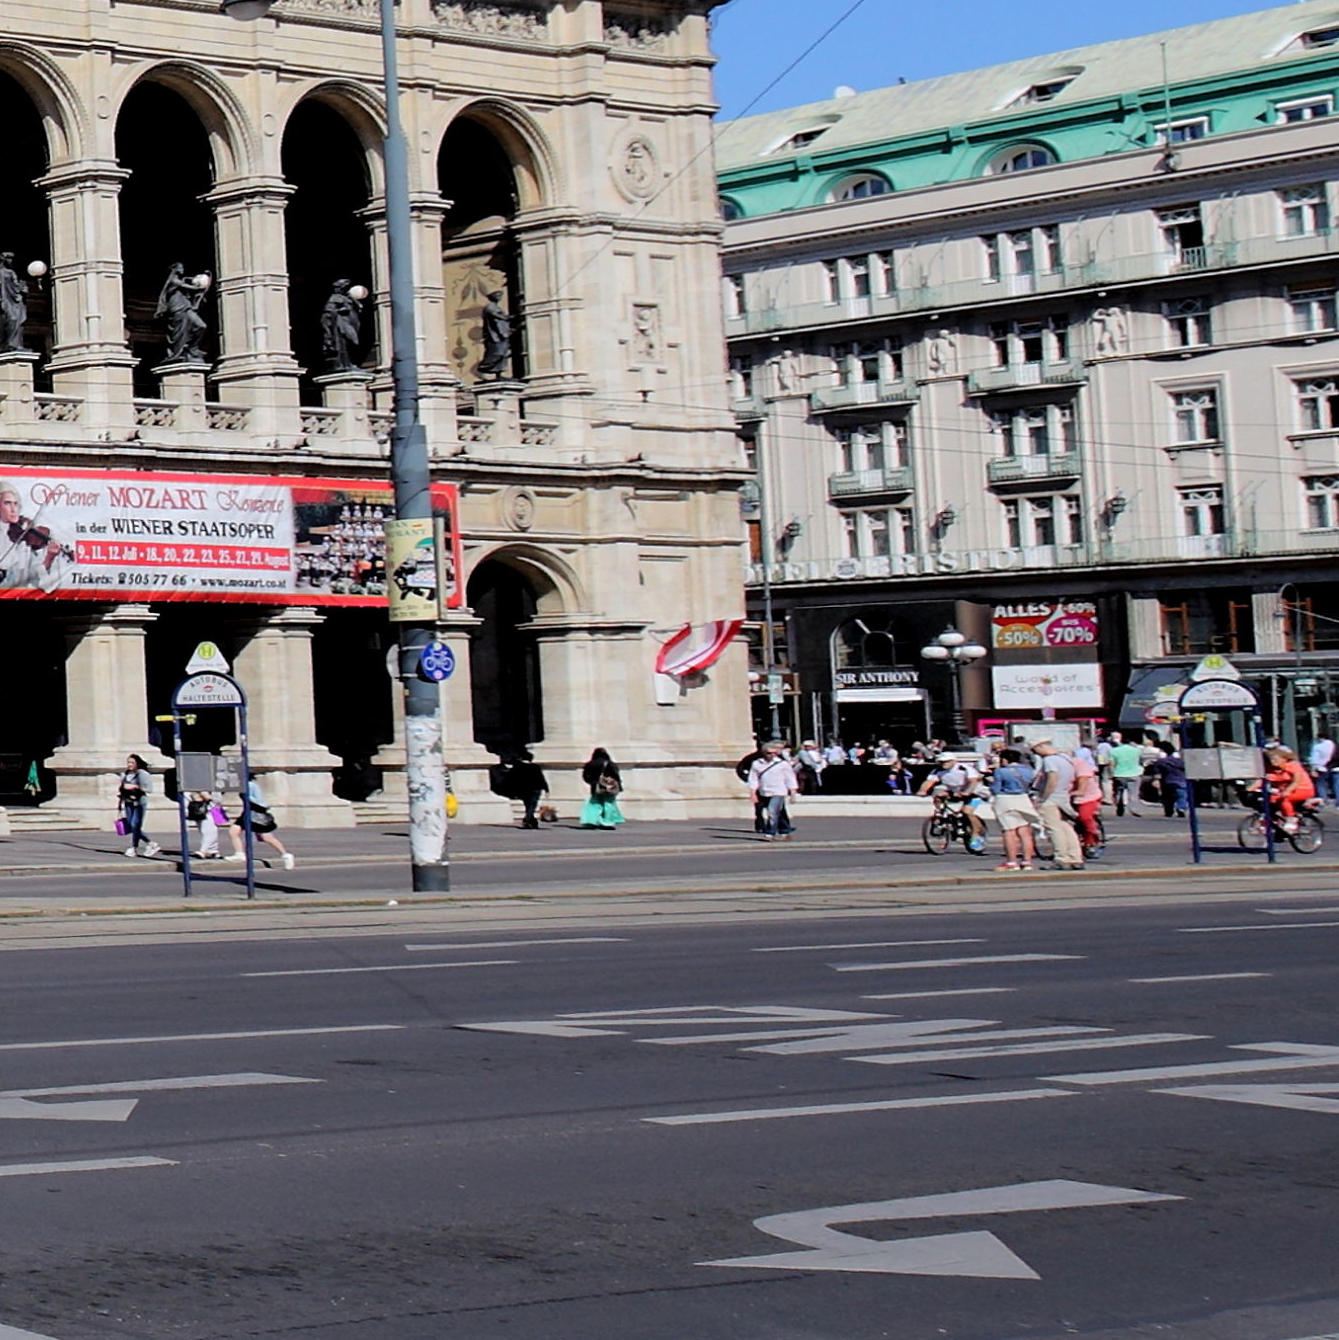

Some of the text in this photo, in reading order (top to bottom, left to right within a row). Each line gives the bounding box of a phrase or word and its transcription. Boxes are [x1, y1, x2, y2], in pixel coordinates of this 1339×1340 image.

[30, 483, 284, 513] Wiener MOZART Konzerte
[76, 518, 275, 540] in der WIENER STAATSOPER
[71, 572, 287, 589] Tickets: 505 77 66 www.mozart.co.at
[994, 604, 1051, 618] ALLES
[998, 631, 1039, 645] -50%
[1047, 626, 1095, 643] -70%
[189, 676, 229, 688] AUTOBUS
[835, 671, 920, 684] SIR ANTHONY
[182, 693, 236, 702] HALTESTELLE
